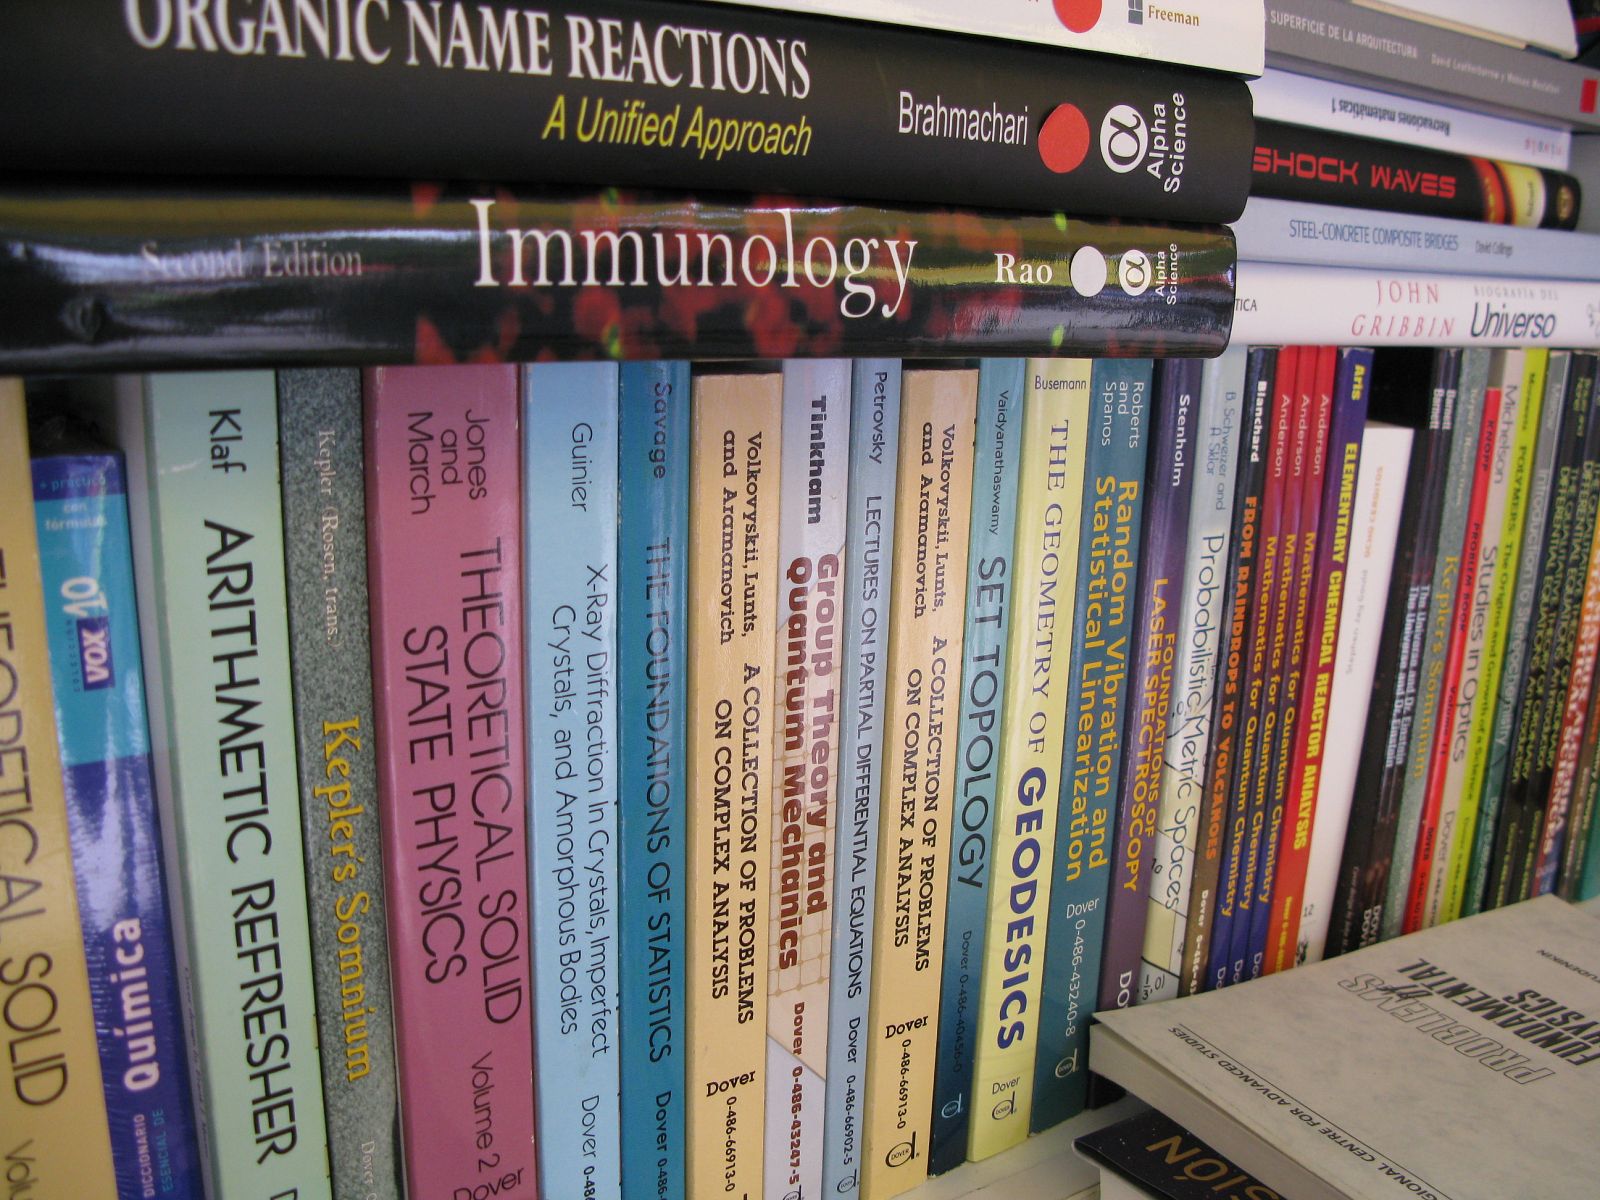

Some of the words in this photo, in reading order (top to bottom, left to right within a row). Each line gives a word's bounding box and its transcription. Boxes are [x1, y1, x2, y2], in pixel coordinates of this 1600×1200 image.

[126, 0, 389, 63] ORGANIC
[407, 0, 552, 75] NAME
[564, 14, 810, 99] REACTIONS
[1149, 5, 1199, 26] Freeman
[1270, 10, 1325, 37] SUPERFICIE
[1328, 26, 1341, 40] DE
[1342, 28, 1353, 42] LA
[1356, 32, 1418, 60] ARQUITECTURA
[541, 95, 565, 140] A
[576, 97, 680, 148] Unified
[682, 104, 812, 159] Approach
[898, 90, 1028, 146] Brahmachari
[1146, 101, 1167, 180] Alpha
[1164, 92, 1185, 193] Science
[1397, 110, 1451, 136] Recreaciones
[1253, 147, 1359, 186] SHOCK
[1371, 165, 1456, 199] WAVES
[141, 240, 244, 278] Second
[263, 240, 362, 277] Edition
[469, 199, 918, 319] Immunology
[995, 252, 1053, 284] Rao
[1289, 219, 1370, 244] STEEL-CONCRETE
[1372, 228, 1422, 249] COMPOSITE
[1425, 233, 1459, 251] BRIDGES
[1351, 314, 1455, 337] GRIBBIN
[1377, 280, 1439, 304] JOHN
[1470, 302, 1556, 338] Universo
[868, 371, 888, 465] Petrovsky
[1034, 375, 1087, 391] Busemann
[1101, 381, 1117, 446] Spanos
[1118, 381, 1128, 415] and
[1128, 381, 1145, 448] Roberts
[1250, 380, 1267, 463] Blanchard
[1351, 364, 1366, 401] Aris
[1441, 389, 1456, 431] Barnett
[209, 409, 246, 473] Klaf
[407, 411, 436, 515] March
[441, 428, 463, 485] and
[466, 409, 489, 500] Jones
[648, 381, 673, 480] Savage
[723, 430, 738, 478] and
[807, 395, 827, 525] Tinkham
[988, 390, 1009, 536] Vaidyanathaswamy
[1047, 419, 1069, 491] THE
[1171, 395, 1190, 487] Stenholm
[1207, 443, 1220, 476] Sklar
[1219, 408, 1235, 478] Schweizer
[1274, 394, 1290, 478] Anderson
[1493, 385, 1517, 485] Michelson
[742, 431, 763, 568] Volkovyskii,
[1216, 483, 1227, 510] and
[1239, 495, 1258, 558] FROM
[1333, 443, 1359, 564] ELEMENTARY
[1522, 469, 1549, 580] Introduction
[645, 536, 671, 601] THE
[720, 486, 738, 644] Aramanovich
[861, 495, 882, 601] LECTURES
[1084, 475, 1116, 651] Statistical
[1108, 479, 1139, 628] Random
[742, 570, 762, 637] Lunts,
[814, 553, 840, 677] Group
[860, 606, 877, 645] ON
[975, 556, 1006, 629] SET
[1032, 503, 1064, 700] GEOMETRY
[1147, 578, 1168, 669] LASER
[1186, 534, 1225, 709] Probabilistic
[1225, 564, 1250, 695] RAINDROPS
[1247, 536, 1278, 674] Mathematics
[1318, 570, 1344, 667] CHEMICAL
[1470, 546, 1498, 641] Studies
[80, 628, 110, 684] VOX
[204, 519, 272, 864] ARITHMETIC
[403, 626, 453, 764] STATE
[744, 662, 761, 685] A
[785, 556, 812, 751] Quantum
[856, 652, 876, 740] PARTIAL
[1249, 677, 1261, 709] for
[1467, 649, 1482, 670] in
[460, 537, 513, 882] THEORETICAL
[645, 612, 671, 854] FOUNDATIONS
[713, 699, 733, 740] ON
[1027, 711, 1047, 754] OF
[1093, 634, 1127, 797] Vibration
[1221, 703, 1238, 729] TO
[1307, 673, 1330, 759] REACTOR
[1452, 678, 1478, 763] Optics
[314, 716, 364, 883] Kepler's
[739, 687, 761, 851] COLLECTION
[806, 688, 836, 829] Theory
[956, 645, 1000, 889] TOPOLOGY
[1066, 661, 1103, 882] Linearization
[1123, 675, 1160, 892] SPECTROSCOPY
[1176, 714, 1206, 800] Metric
[1206, 734, 1232, 861] VOLCANOES
[1237, 715, 1258, 812] Quantum
[713, 745, 733, 875] COMPLEX
[849, 743, 872, 883] DIFFERENTIAL
[1088, 808, 1108, 869] and
[1293, 764, 1317, 852] ANALYSIS
[412, 784, 468, 985] PHYSICS
[646, 861, 671, 904] OF
[739, 857, 757, 891] OF
[778, 763, 807, 970] Mechanics
[806, 839, 828, 915] and
[1164, 806, 1196, 910] Spaces
[1222, 816, 1246, 918] Chemistry
[712, 882, 730, 1000] ANALYSIS
[848, 885, 867, 999] EQUATIONS
[997, 767, 1047, 1050] GEODESICS
[1066, 897, 1100, 920] Dover
[335, 892, 370, 1081] Somnium
[478, 889, 523, 1025] SOLID
[647, 911, 673, 1064] STATISTICS
[737, 899, 758, 1025] PROBLEMS
[1065, 919, 1086, 1037] 0-486-43240-8
[110, 917, 160, 1092] Química
[231, 879, 298, 1165] REFRESHER
[792, 1002, 805, 1057] Dover
[847, 1016, 861, 1064] Dover
[885, 1016, 928, 1039] Dover
[1168, 1026, 1216, 1060] STUDIES
[1337, 973, 1556, 1085] PROBLEMS
[1397, 958, 1600, 1066] FUNDAMENTAL
[153, 1109, 164, 1127] DE
[470, 1051, 494, 1150] Volume
[581, 1095, 599, 1158] Dover
[656, 1091, 672, 1152] Dover
[789, 1065, 803, 1185] 0-486-43247-5
[843, 1075, 856, 1165] 0-486-66902-5
[897, 1039, 911, 1129] 0-486-66913-0
[992, 1076, 1020, 1095] Dover
[1218, 1060, 1292, 1107] ADVANCED
[1290, 1107, 1321, 1129] FOR
[135, 1113, 154, 1198] DICCIONARIO
[153, 1131, 173, 1193] ESENCIAL
[477, 1153, 500, 1173] 2
[1318, 1128, 1376, 1163] CENTRE
